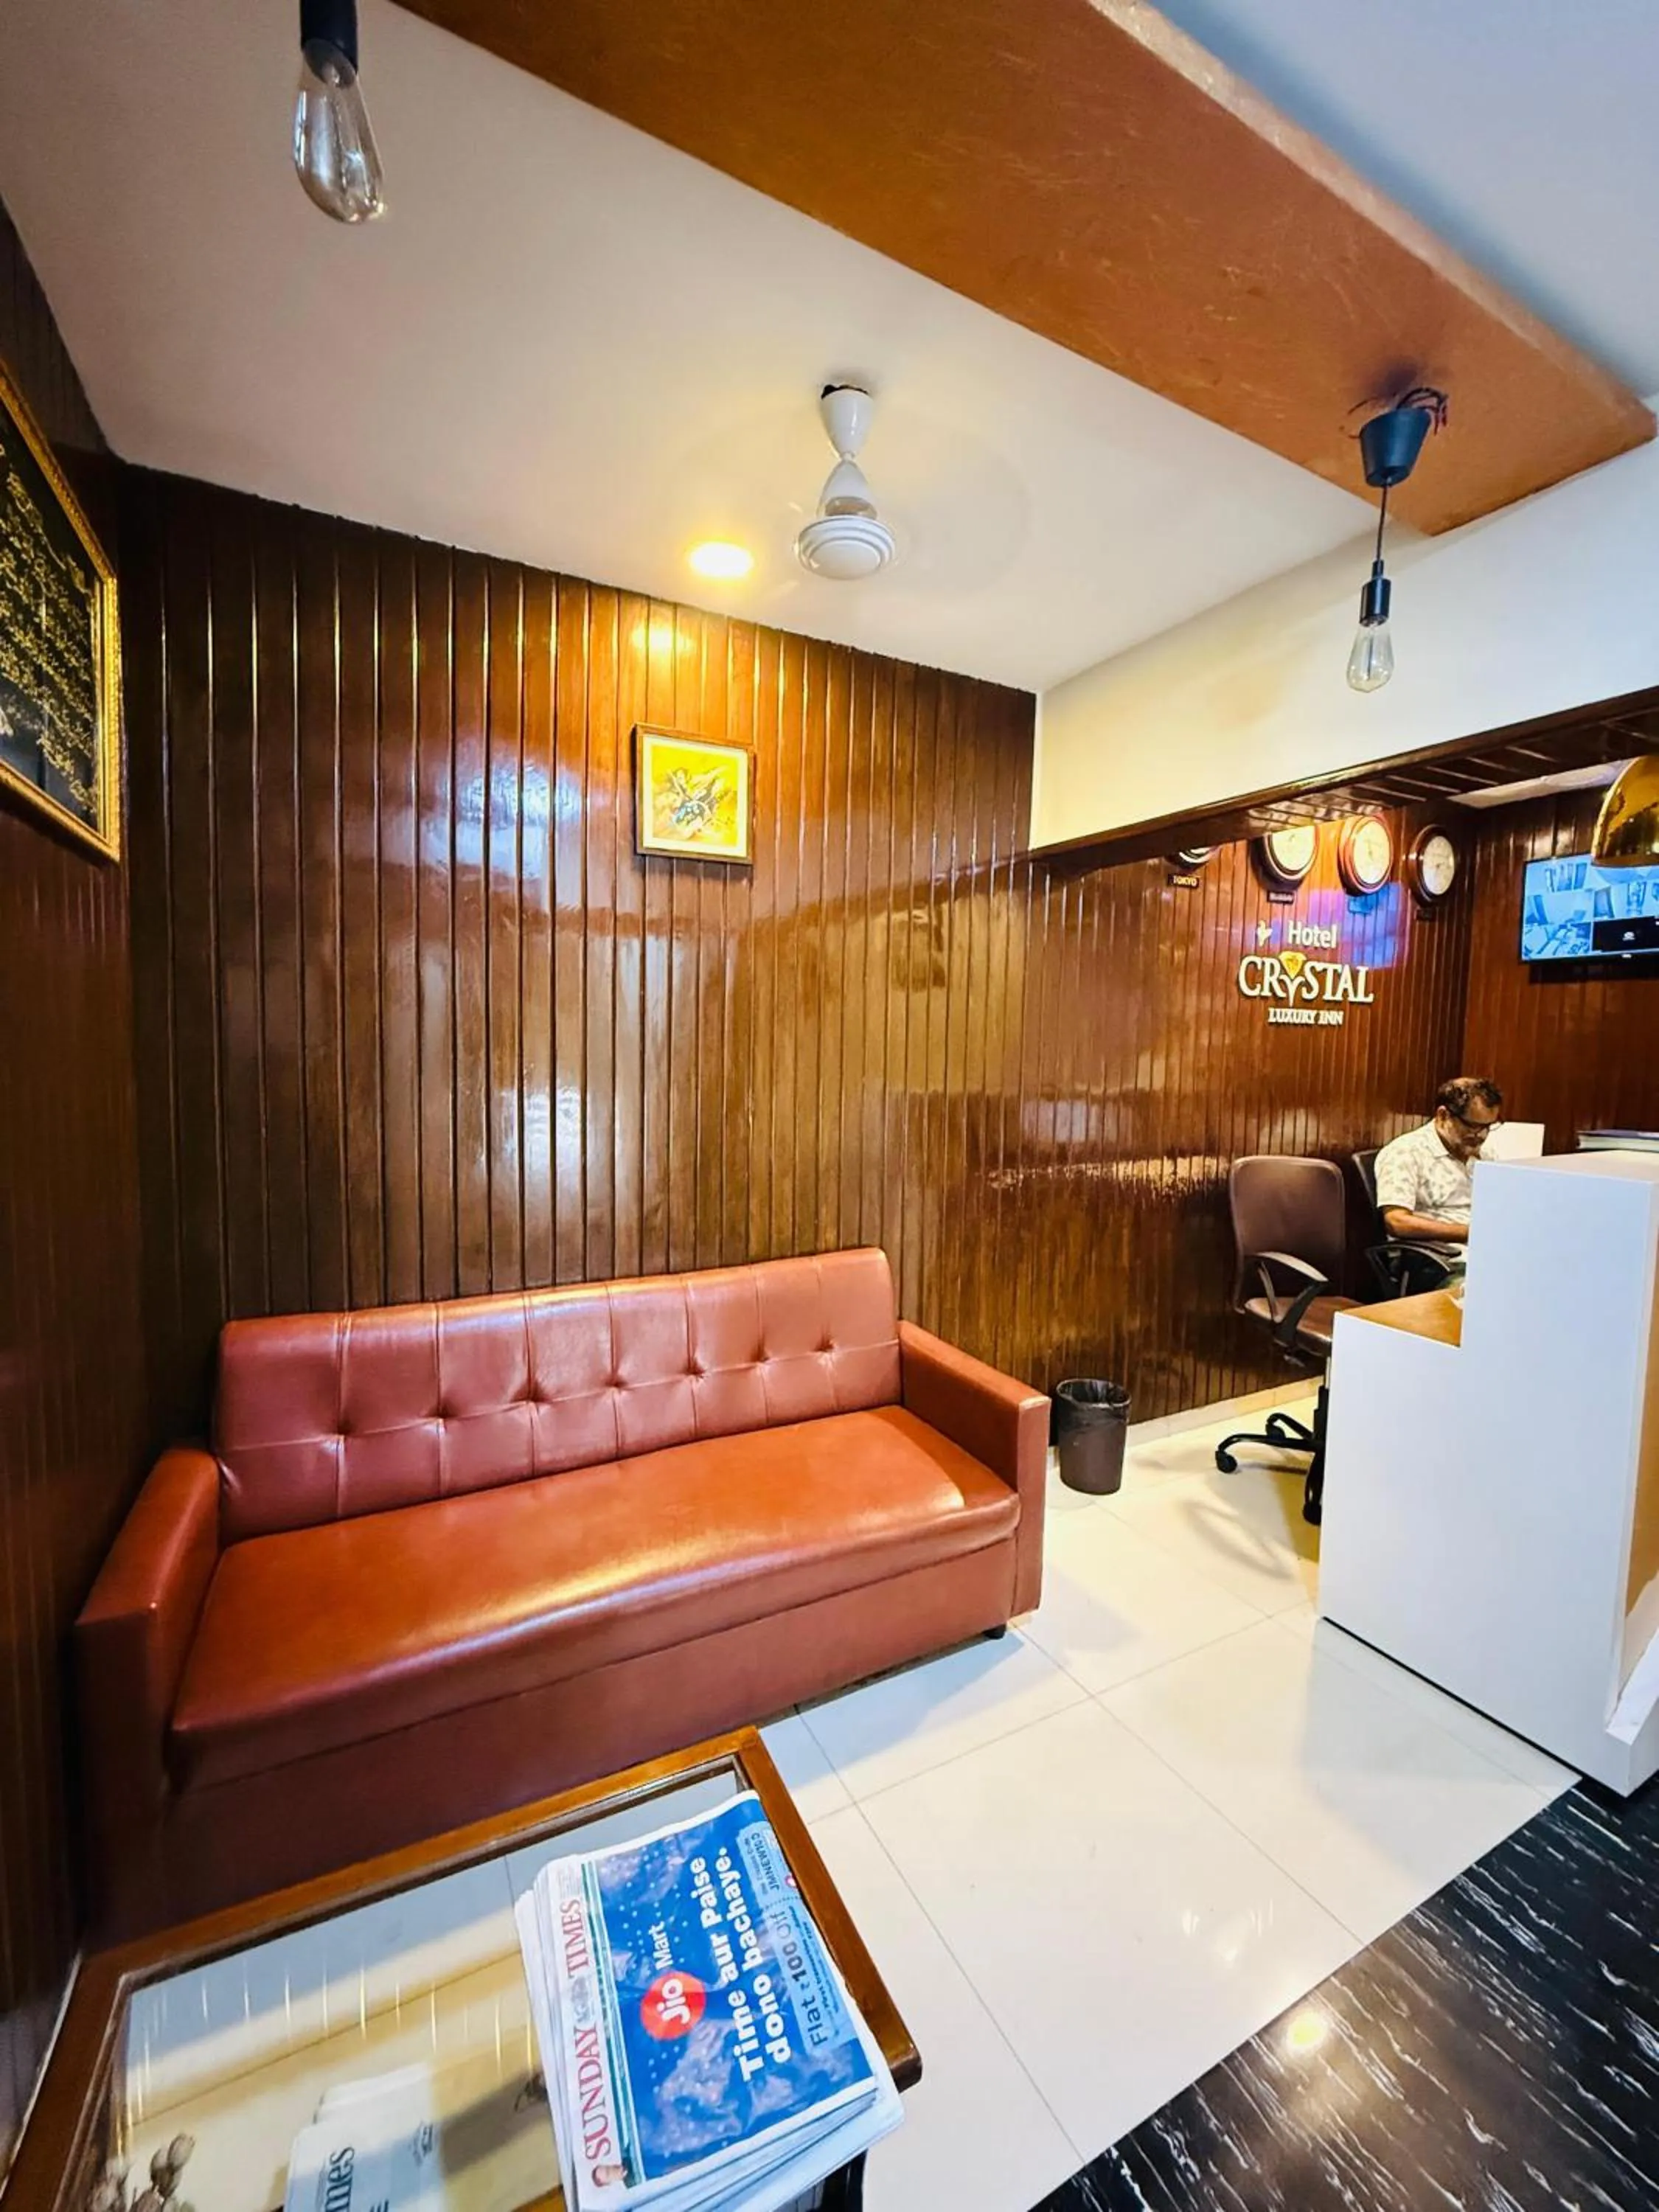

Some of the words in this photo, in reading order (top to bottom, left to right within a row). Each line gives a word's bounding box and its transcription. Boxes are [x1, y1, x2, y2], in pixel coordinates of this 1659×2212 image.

[1173, 875, 1197, 886] TOKYO
[1287, 920, 1338, 949] Hotel
[1238, 954, 1374, 1007] CRYSTAL
[1268, 1007, 1316, 1024] LUXURY
[1318, 1009, 1343, 1026] INN
[689, 1856, 723, 1930] Paise
[715, 1846, 764, 1972] bachaye.
[560, 1899, 590, 1980] TIMES
[649, 1921, 674, 1970] Mart
[709, 1931, 740, 1983] aur
[656, 1978, 691, 2025] Jio
[754, 1975, 792, 2064] dono
[799, 1994, 829, 2047] Flat
[728, 1991, 765, 2082] Time
[574, 2024, 611, 2160] SUNDAY
